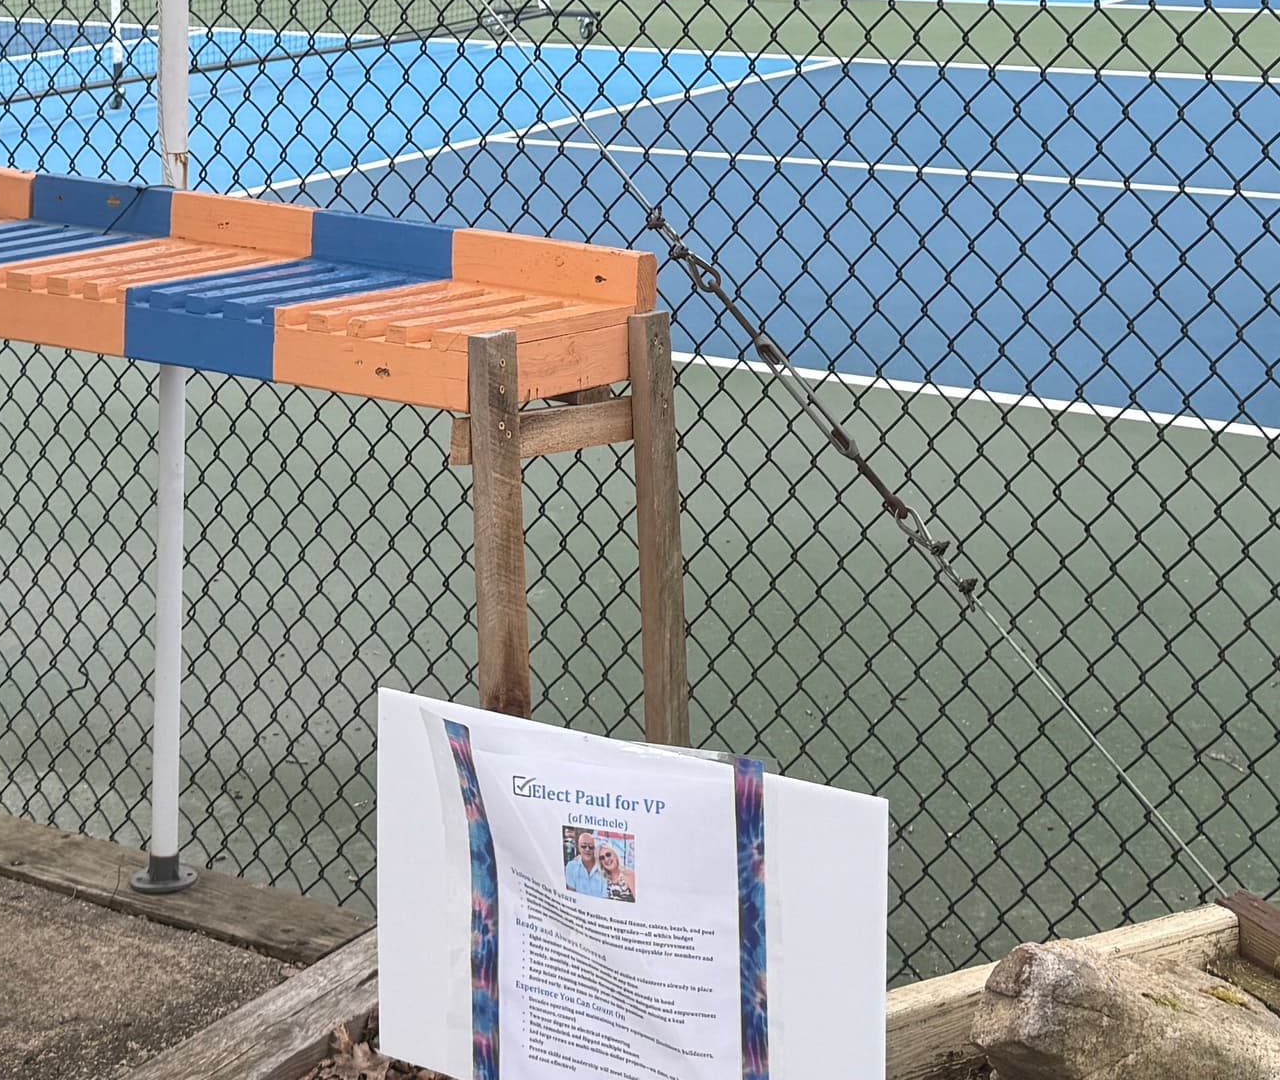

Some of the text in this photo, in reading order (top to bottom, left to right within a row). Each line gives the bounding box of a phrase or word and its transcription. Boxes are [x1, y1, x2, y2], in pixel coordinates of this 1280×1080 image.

[532, 784, 666, 815] Elect Paul for VP
[516, 918, 538, 932] Ready
[515, 980, 559, 999] Experience
[560, 990, 575, 1004] You
[576, 997, 591, 1009] Can
